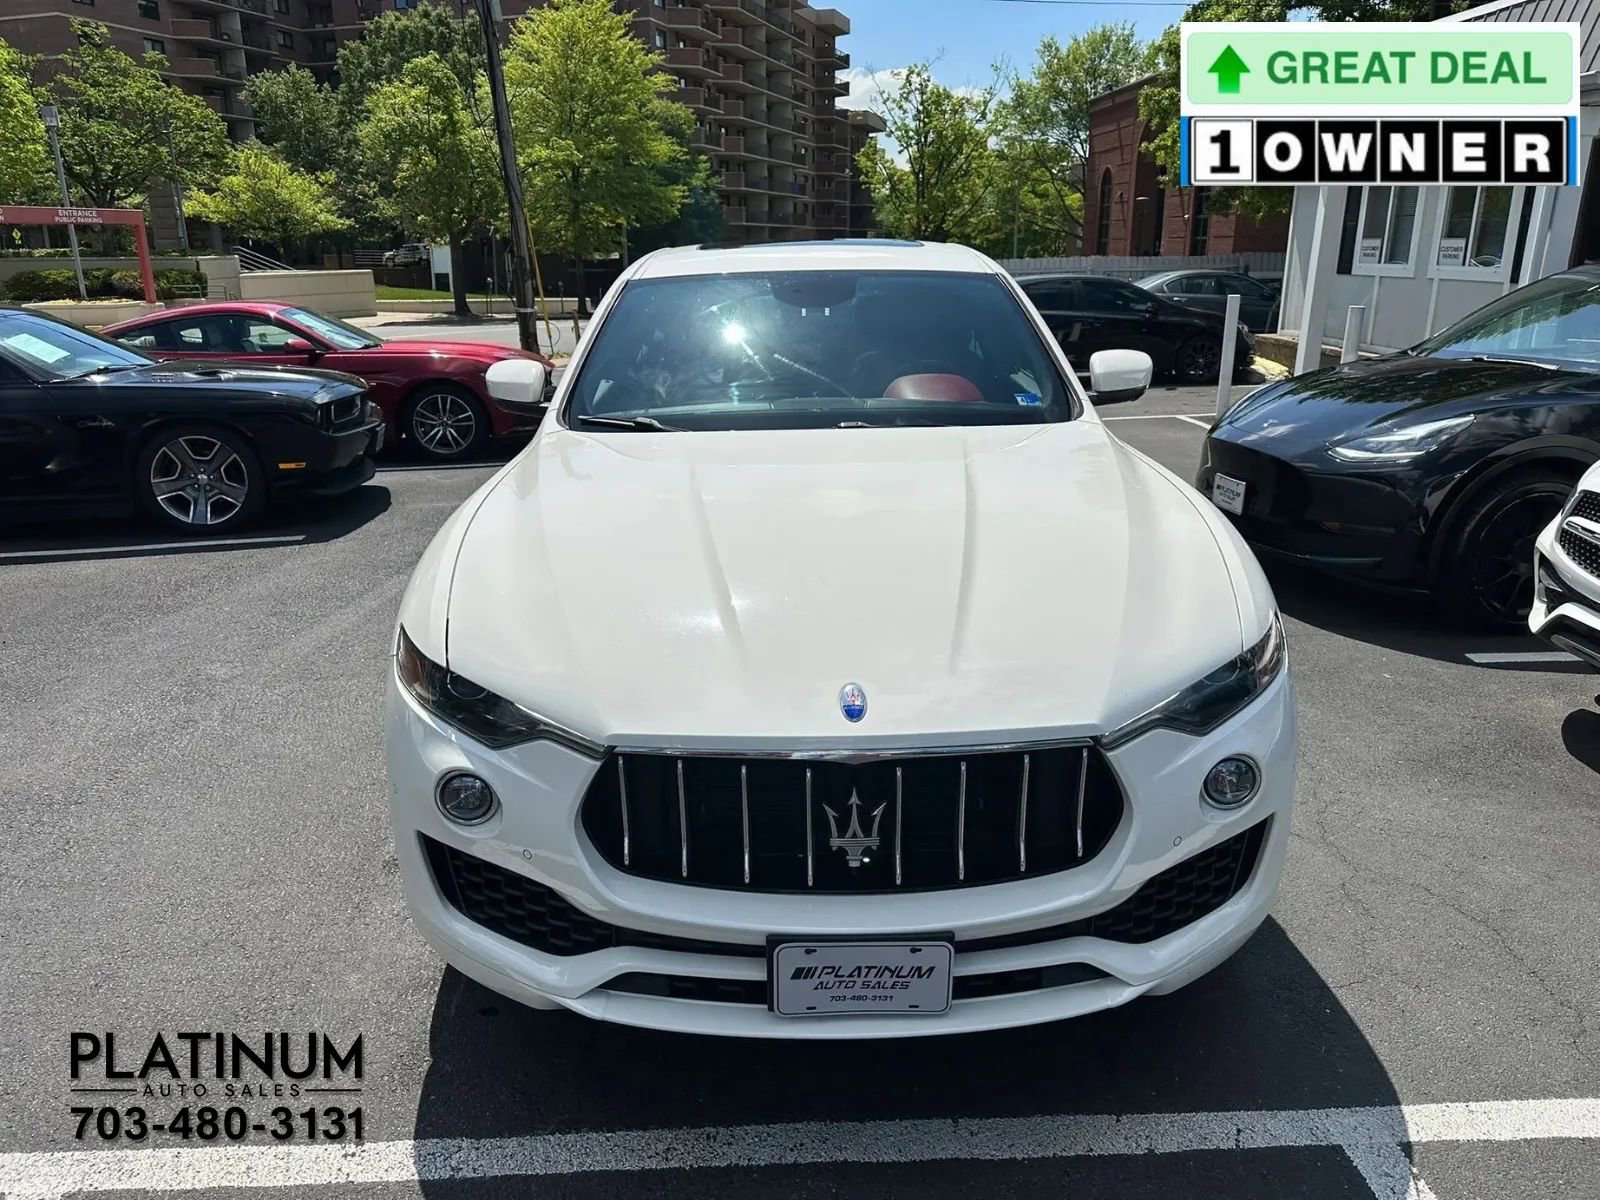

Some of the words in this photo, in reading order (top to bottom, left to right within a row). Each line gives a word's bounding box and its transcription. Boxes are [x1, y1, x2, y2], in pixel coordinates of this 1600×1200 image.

[58, 209, 97, 217] ENTRANCE
[816, 965, 937, 979] PLATINUM
[813, 980, 857, 990] AUTO
[859, 980, 911, 990] SALES
[829, 994, 894, 1002] 703-480-3131
